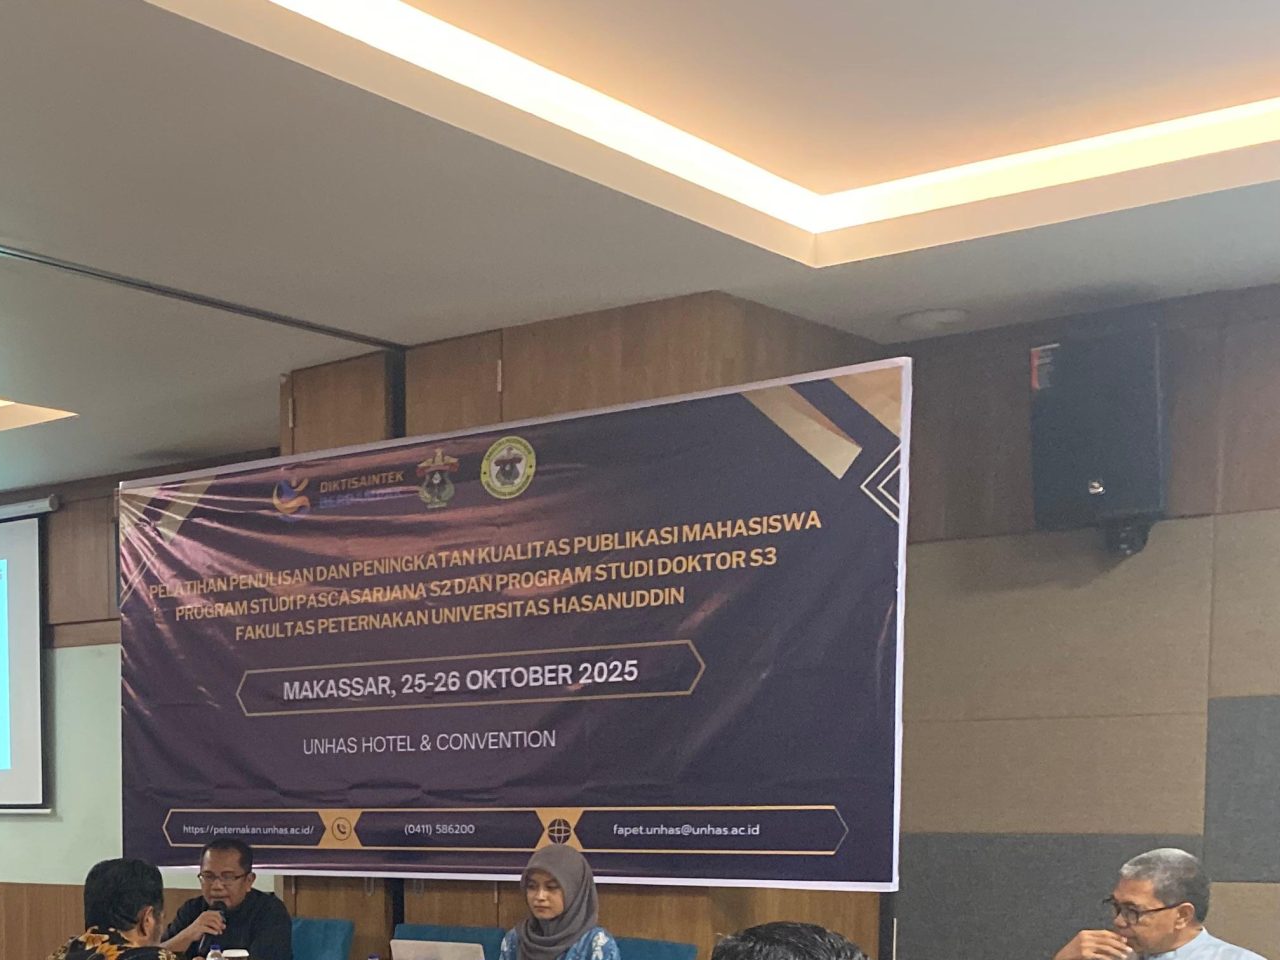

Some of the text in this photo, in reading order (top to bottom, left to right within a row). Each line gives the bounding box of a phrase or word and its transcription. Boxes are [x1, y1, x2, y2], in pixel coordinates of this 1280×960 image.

[320, 471, 404, 493] DIKTISAINTEK
[149, 510, 822, 599] PELATIHAN PENULISAN DAN PENINGKATAN KUALITAS PUBLIKASI MAHASISWA
[175, 547, 777, 621] PROGRAM STUDI PASCASARJANA S2 DAN PROGRAM STUDI DOKTOR S3
[235, 587, 685, 642] FAKULTAS PETERNAKAN UNIVERSITAS HASANUDDIN
[283, 660, 639, 701] MAKASSAR, 25-26 OKTOBER 2025
[303, 729, 556, 755] UNHAS HOTEL & CONVENTION
[183, 824, 315, 837] https://peternakan.unhas.ac.id/
[404, 823, 475, 836] (0411) 586200
[613, 823, 760, 838] fapet.unhas@unhas.ac.id
